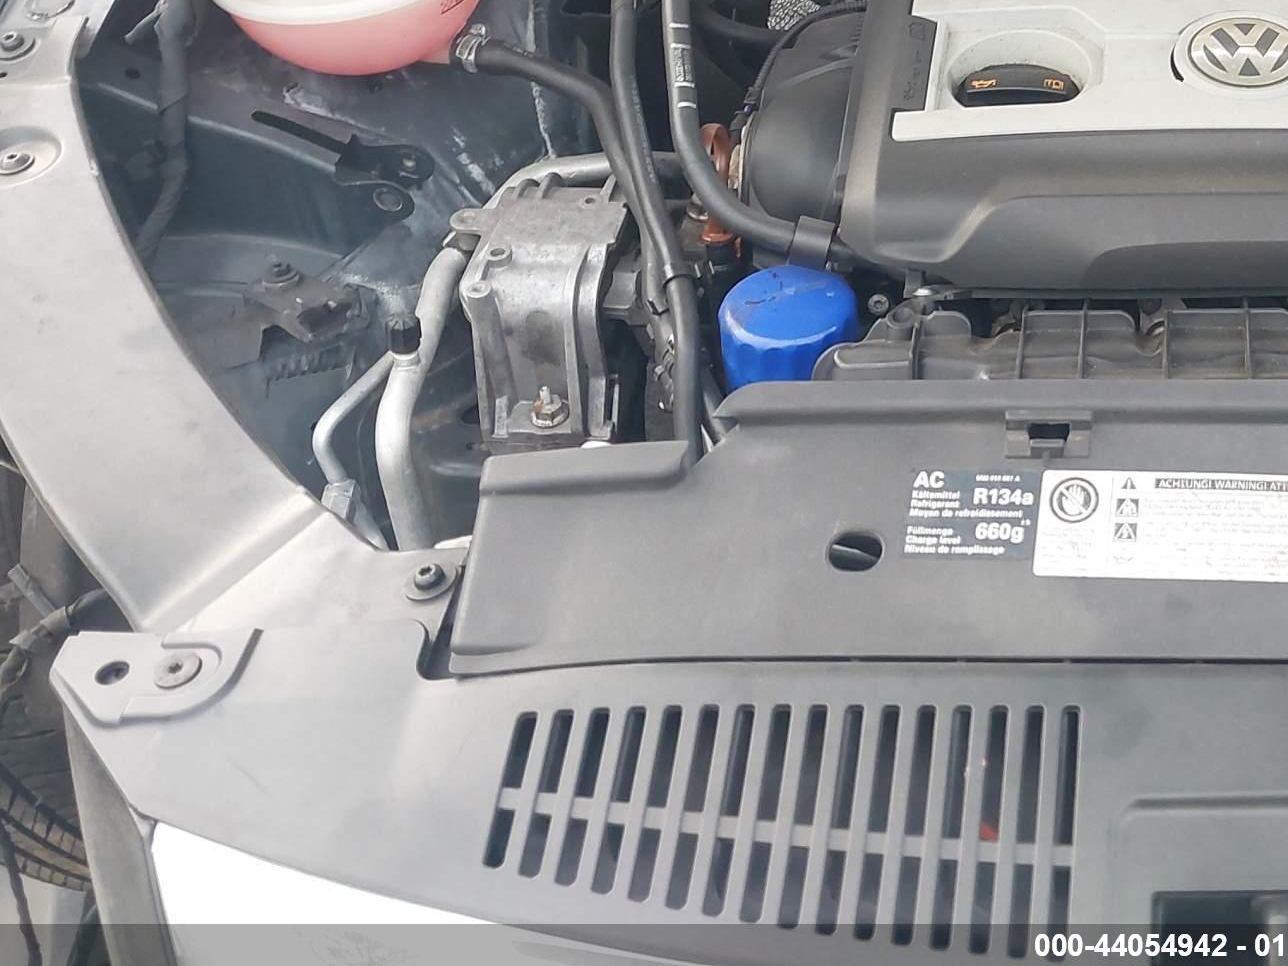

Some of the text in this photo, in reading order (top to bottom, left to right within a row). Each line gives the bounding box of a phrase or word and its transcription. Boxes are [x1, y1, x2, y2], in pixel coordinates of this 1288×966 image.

[913, 470, 945, 489] AC
[1214, 480, 1268, 491] WARNING!
[973, 487, 1034, 506] R134a
[942, 509, 953, 517] de
[975, 522, 1025, 544] 660g
[937, 545, 950, 554] de
